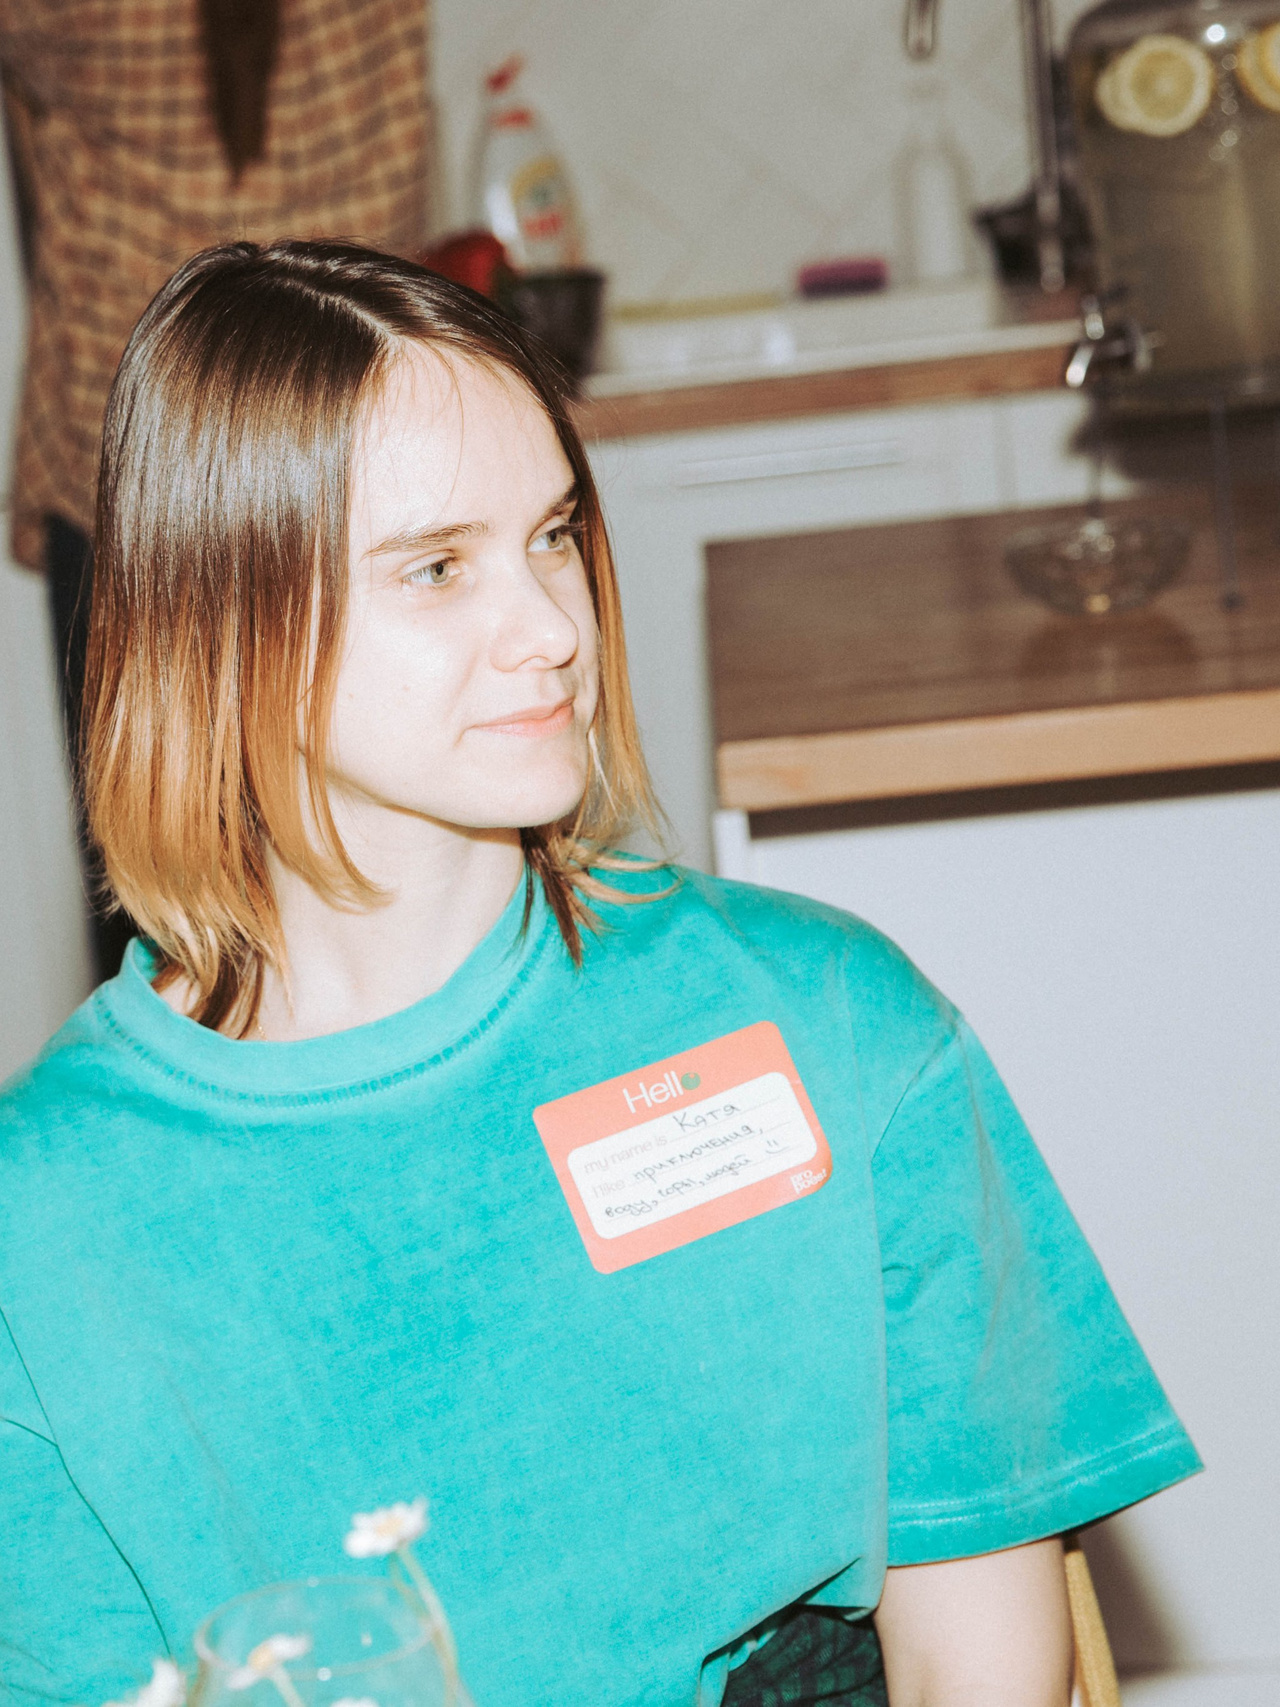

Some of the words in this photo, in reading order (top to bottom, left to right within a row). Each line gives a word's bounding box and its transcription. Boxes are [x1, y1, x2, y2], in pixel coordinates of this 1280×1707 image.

[622, 1070, 701, 1114] Hello
[584, 1157, 609, 1174] my
[611, 1140, 653, 1164] name
[655, 1134, 667, 1147] is
[599, 1179, 625, 1197] like
